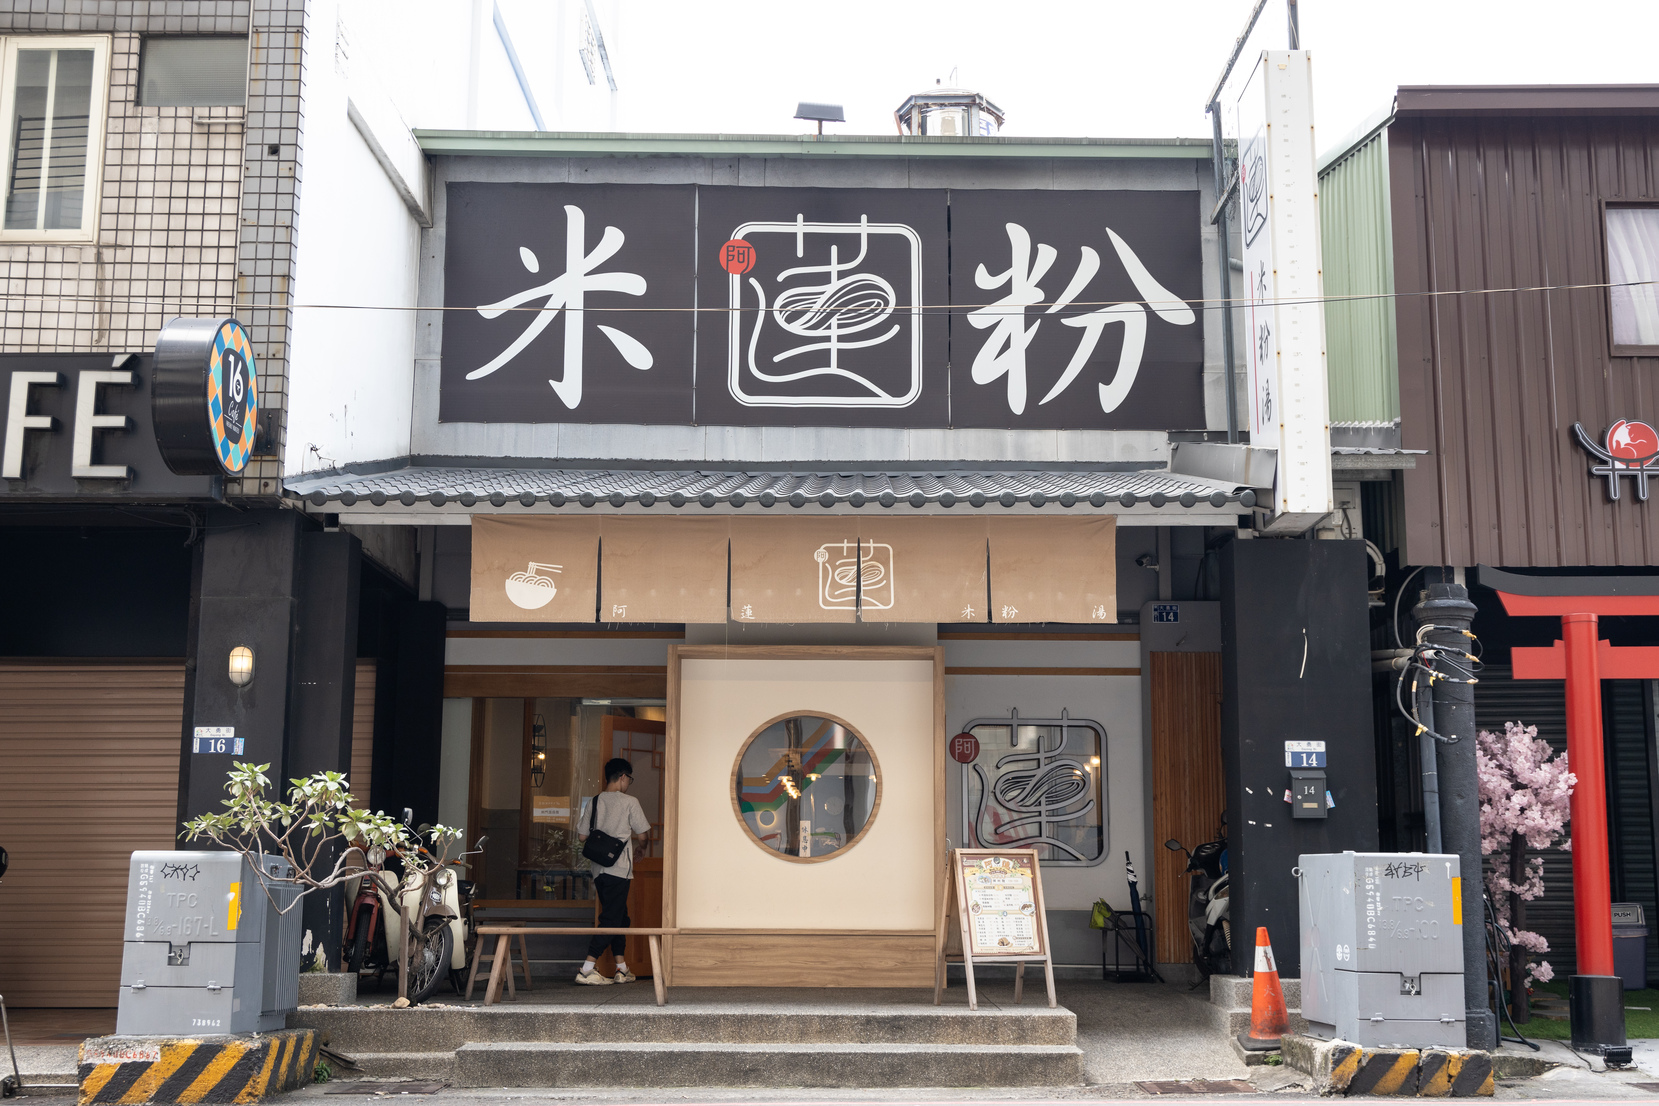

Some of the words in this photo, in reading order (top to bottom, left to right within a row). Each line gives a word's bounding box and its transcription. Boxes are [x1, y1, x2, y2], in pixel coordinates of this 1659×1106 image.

[465, 204, 654, 410] 米
[966, 222, 1196, 415] 粉
[228, 353, 243, 403] 16
[228, 400, 239, 424] Café
[1162, 612, 1175, 622] 14
[208, 738, 226, 753] 16
[1300, 752, 1318, 767] 14
[1303, 785, 1315, 795] 14
[166, 892, 198, 908] TPC
[1392, 896, 1424, 912] TPC
